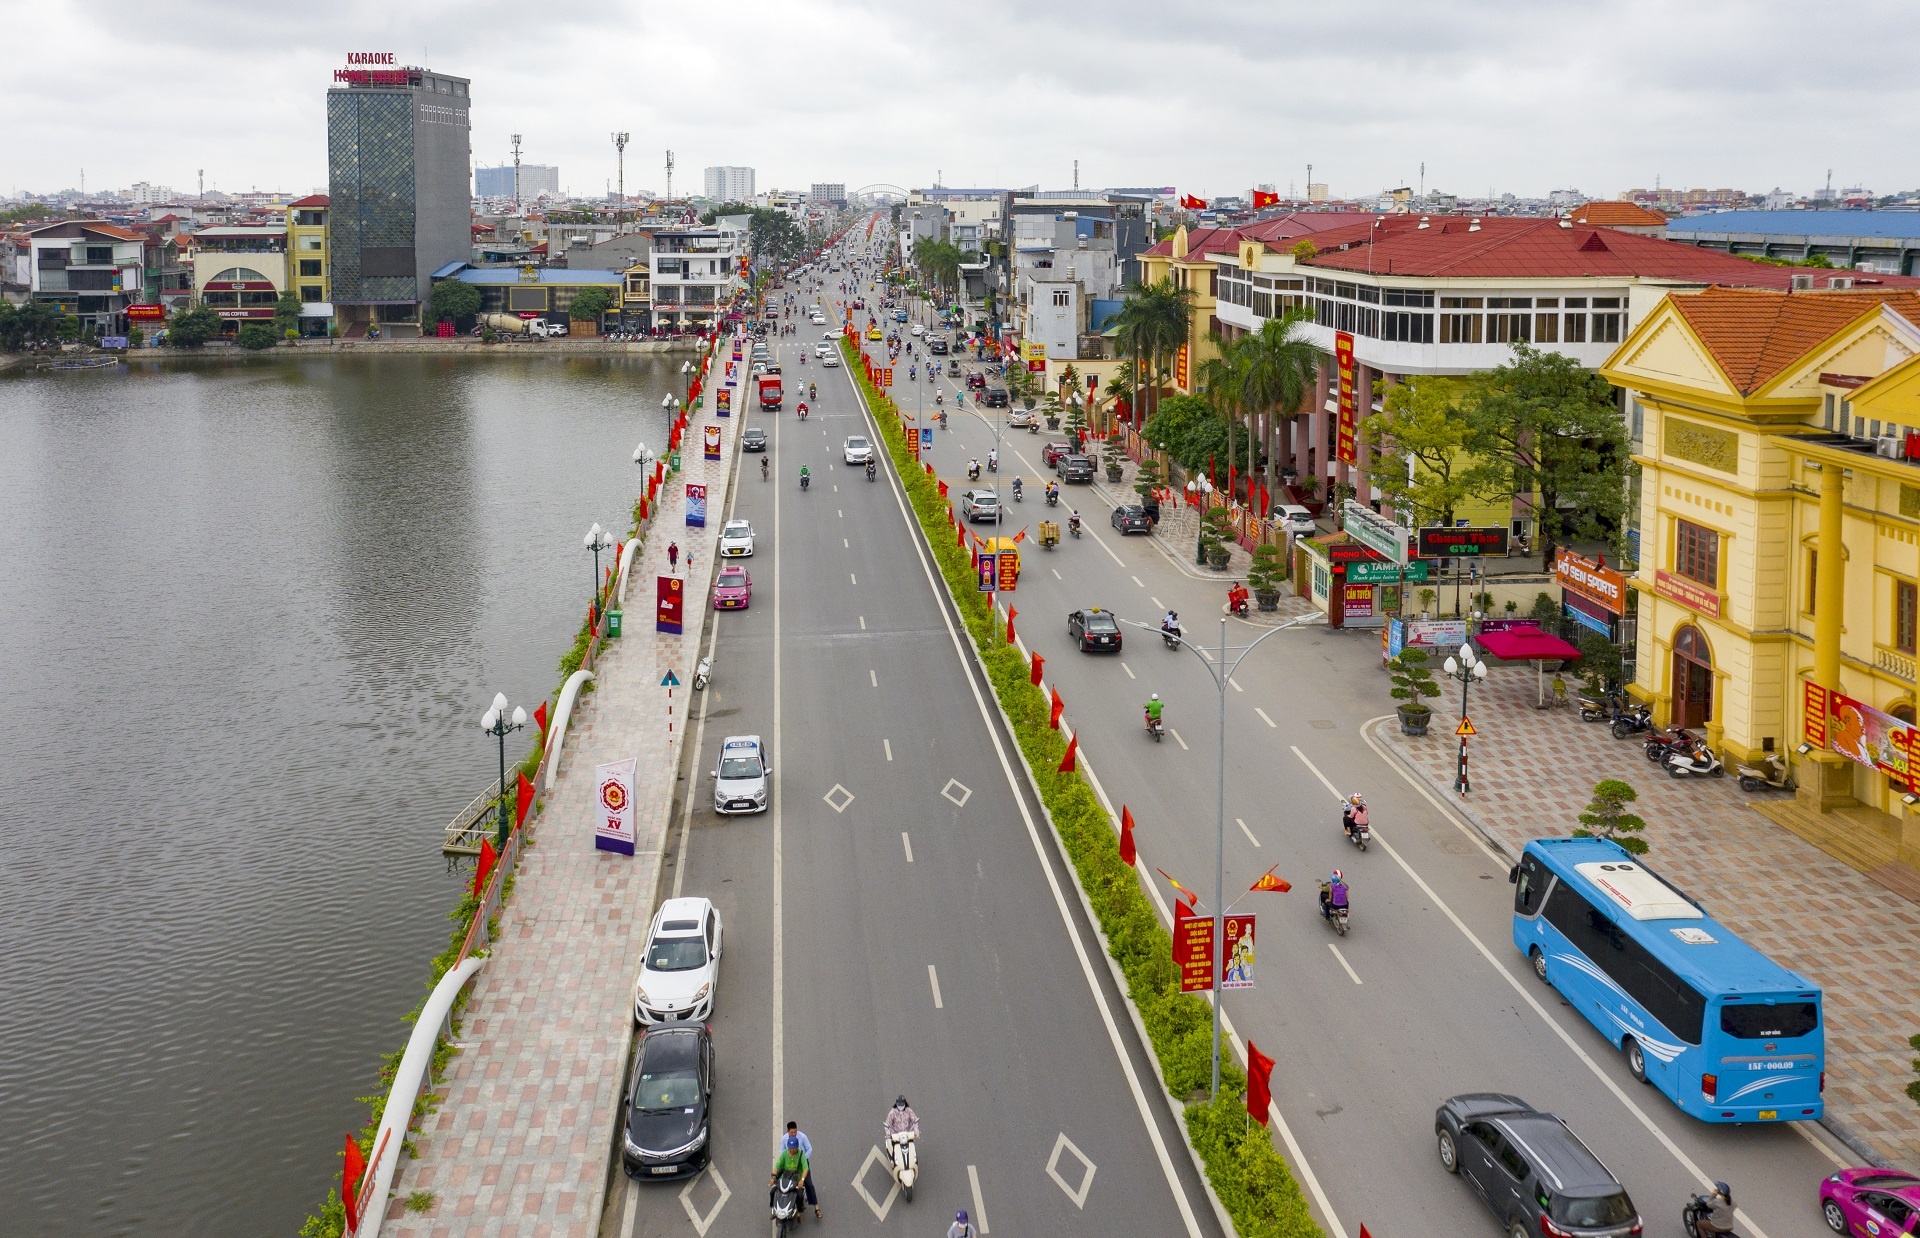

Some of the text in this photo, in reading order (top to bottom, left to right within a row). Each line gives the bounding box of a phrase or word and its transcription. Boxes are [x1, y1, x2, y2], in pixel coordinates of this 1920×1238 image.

[347, 52, 394, 64] KARAOKE
[1427, 533, 1465, 544] Chung
[1449, 545, 1479, 553] GYM
[1570, 565, 1587, 584] SEN
[1587, 574, 1618, 599] SPORTS
[607, 819, 621, 829] XV
